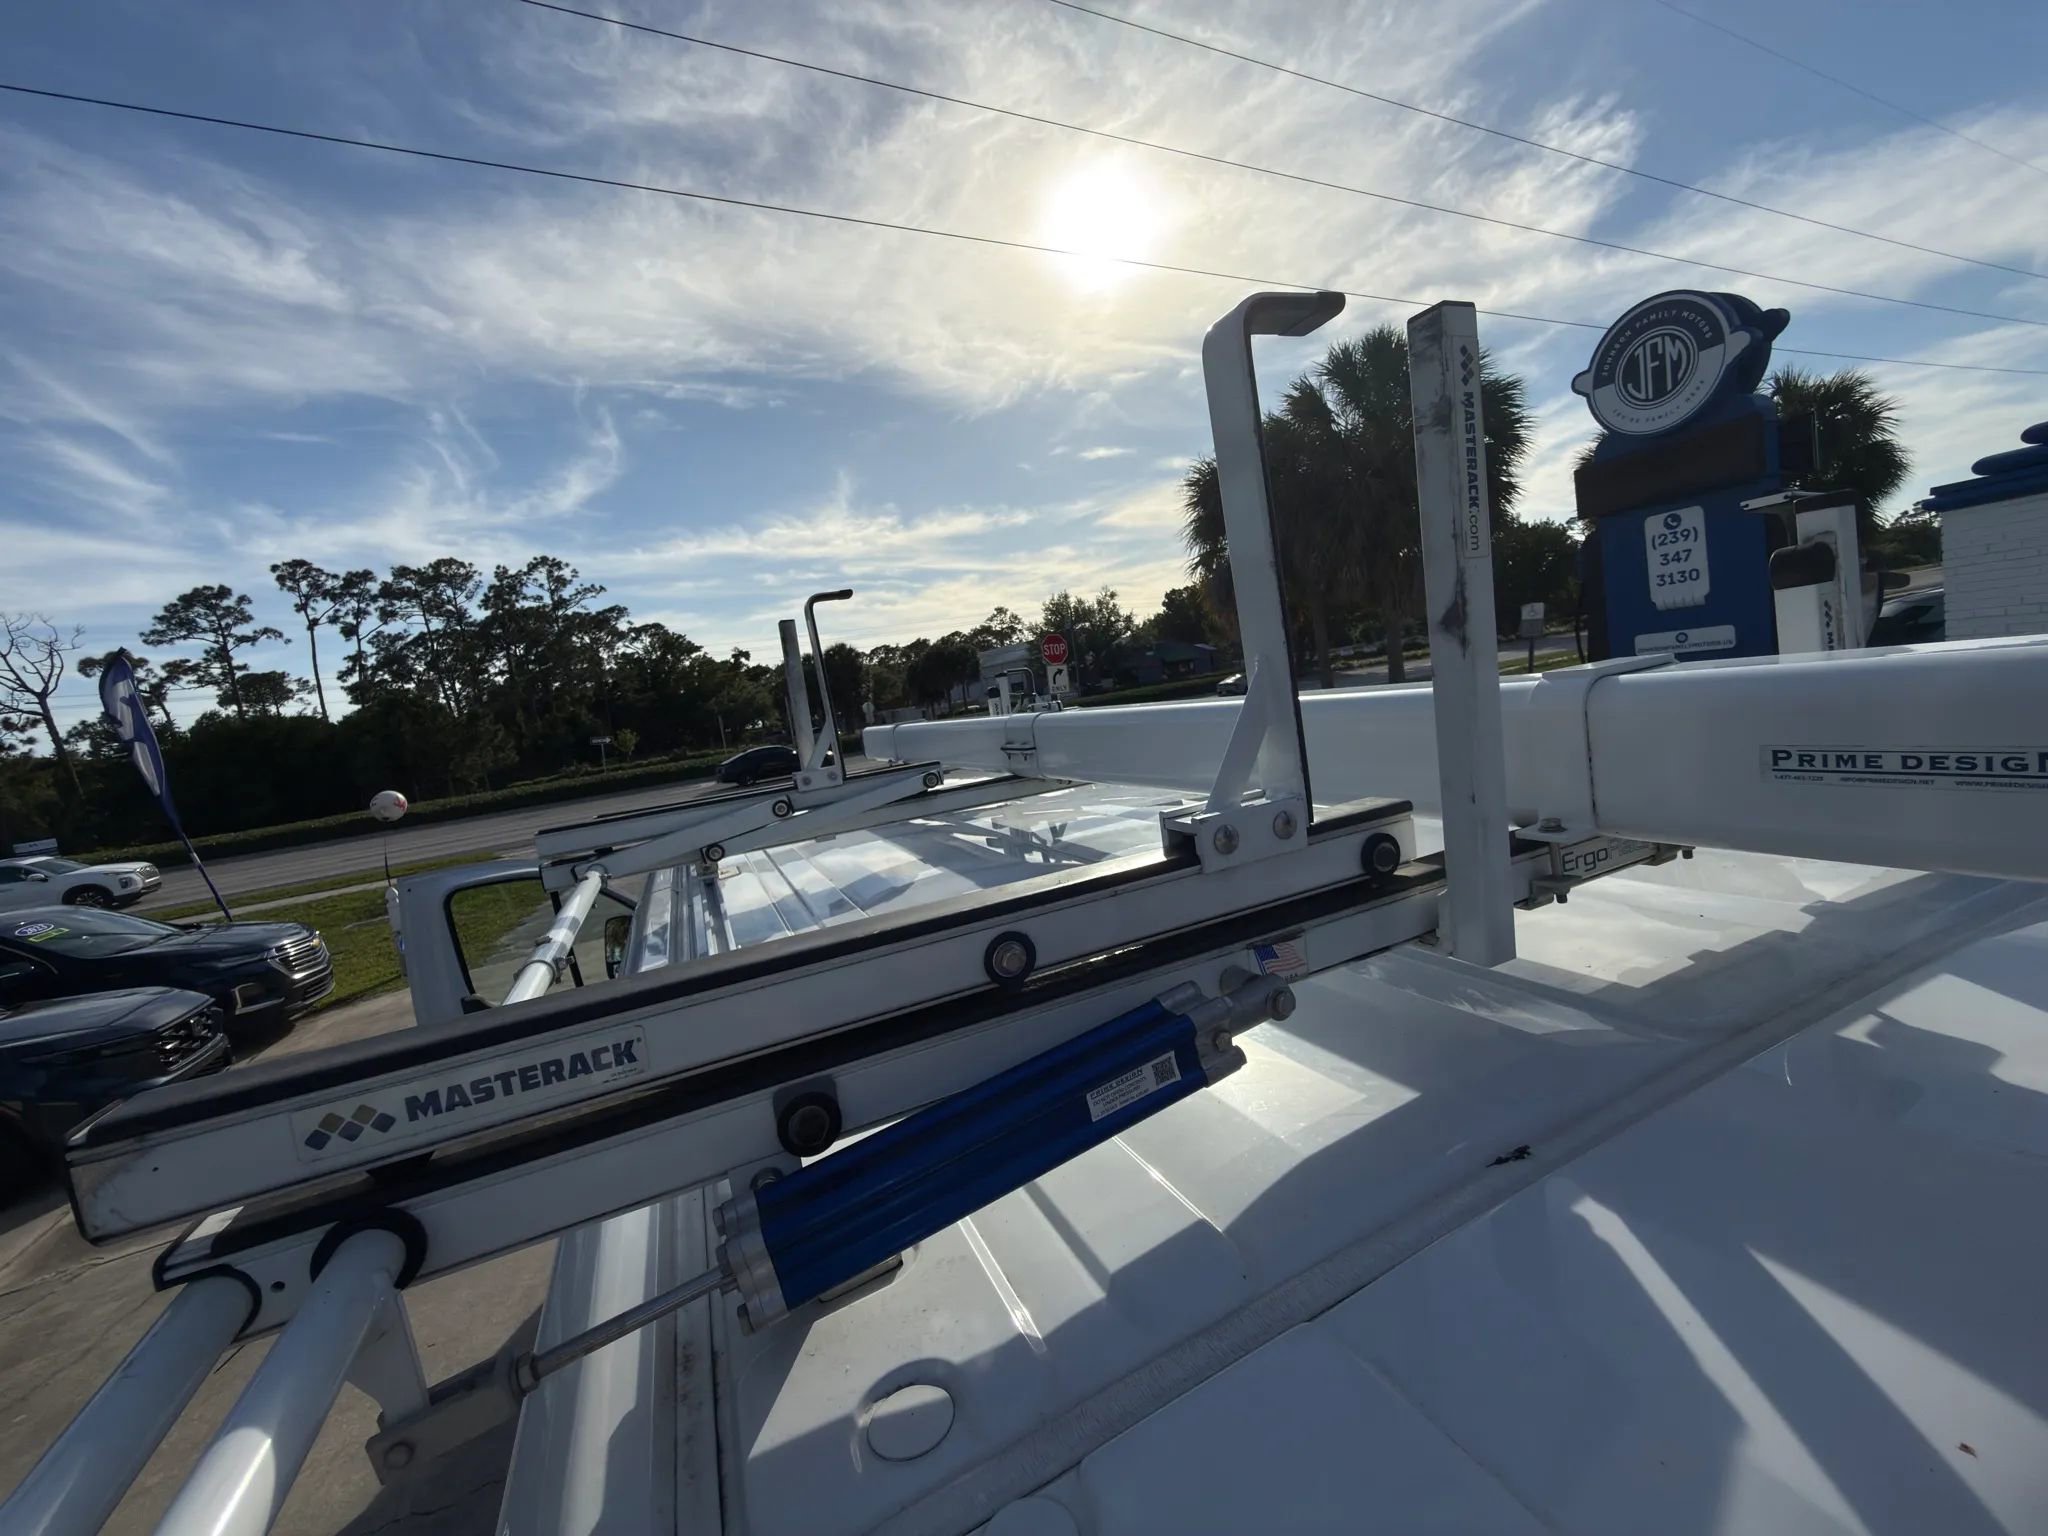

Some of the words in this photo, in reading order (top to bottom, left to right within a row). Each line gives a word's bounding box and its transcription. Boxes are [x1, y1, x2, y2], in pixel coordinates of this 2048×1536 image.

[1635, 310, 1678, 329] FAMILY
[1681, 310, 1712, 339] MOTORS
[1627, 335, 1688, 400] JFM
[1652, 526, 1698, 550] (239)
[1659, 549, 1692, 566] 347
[1656, 568, 1700, 587] 3130
[1044, 643, 1066, 656] STOP
[1771, 749, 1883, 769] PRIME
